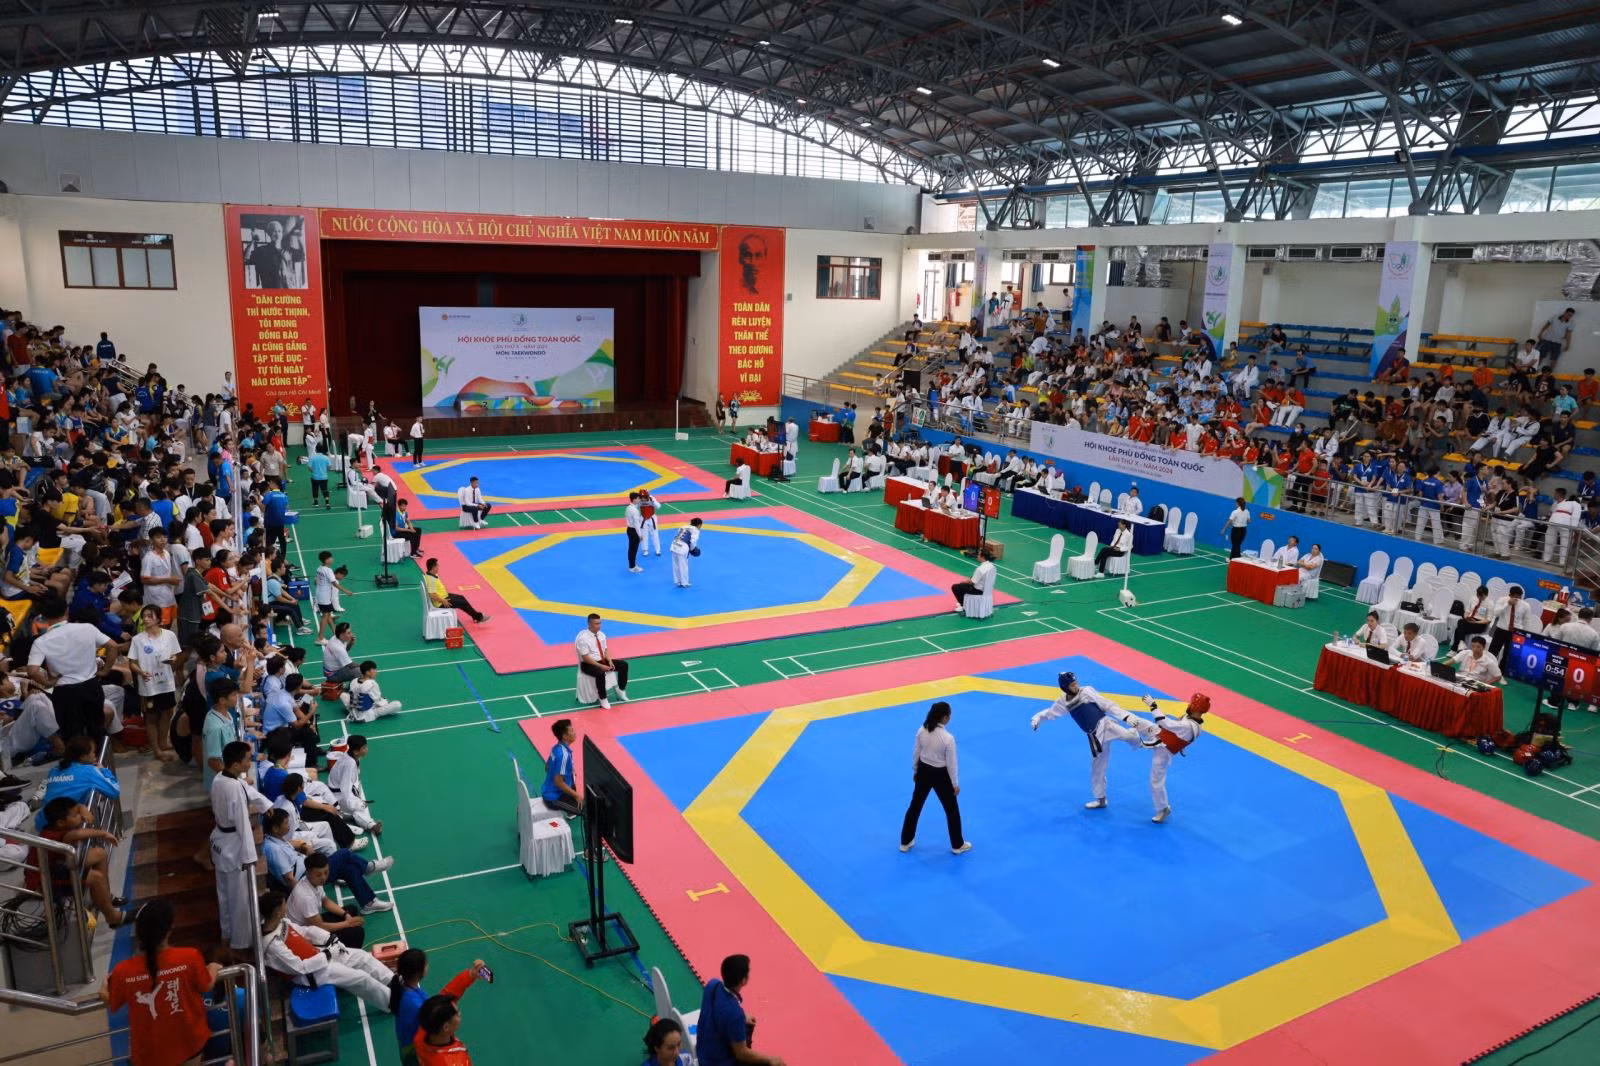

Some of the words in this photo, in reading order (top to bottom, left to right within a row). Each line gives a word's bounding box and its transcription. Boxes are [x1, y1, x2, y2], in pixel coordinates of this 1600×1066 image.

[332, 214, 374, 232] NƯỚC
[378, 215, 418, 236] CỘNG
[422, 217, 451, 234] HÒA
[456, 219, 474, 235] XÃ
[478, 219, 502, 239] HỘI
[506, 220, 534, 237] CHỦ
[537, 222, 578, 238] NGHĨA
[582, 224, 611, 242] VIỆT
[614, 228, 642, 241] NAM
[644, 226, 680, 242] MUÔN
[683, 228, 710, 244] NĂM
[275, 295, 302, 304] CƯỜNG
[246, 307, 259, 316] THÌ
[262, 307, 282, 316] NƯỚC
[285, 308, 310, 318] THỊNH,
[733, 302, 753, 312] TOÀN
[754, 302, 770, 312] DÂN
[258, 319, 272, 328] TÔI
[274, 320, 297, 328] MONG
[732, 316, 746, 326] RÈN
[748, 316, 771, 328] LUYỆN
[258, 329, 280, 340] ĐỒNG
[282, 330, 298, 340] BÀO
[560, 334, 582, 343] QUỐC
[734, 330, 754, 340] THÂN
[755, 329, 769, 340] THỂ
[252, 343, 260, 351] AI
[262, 341, 284, 351] CŨNG
[286, 340, 307, 351] GẮNG
[728, 346, 747, 354] THEO
[748, 345, 773, 354] GƯƠNG
[252, 353, 268, 365] TẬP
[270, 352, 285, 363] THỂ
[286, 354, 302, 364] DỤC
[738, 358, 752, 368] BÁC
[754, 357, 764, 368] HỒ
[257, 366, 268, 376] TỰ
[270, 364, 282, 374] TÔI
[284, 365, 304, 374] NGÀY
[252, 376, 268, 386] NÀO
[270, 376, 290, 386] CŨNG
[740, 372, 748, 382] VĨ
[748, 374, 762, 384] ĐẠI
[1084, 441, 1097, 450] HỘI
[1118, 448, 1133, 456] PHÙ
[1158, 456, 1179, 468] TOÀN
[1180, 461, 1204, 472] QUỐC
[1527, 654, 1537, 669] 0
[1545, 664, 1565, 676] 0:54
[1573, 668, 1584, 683] 0
